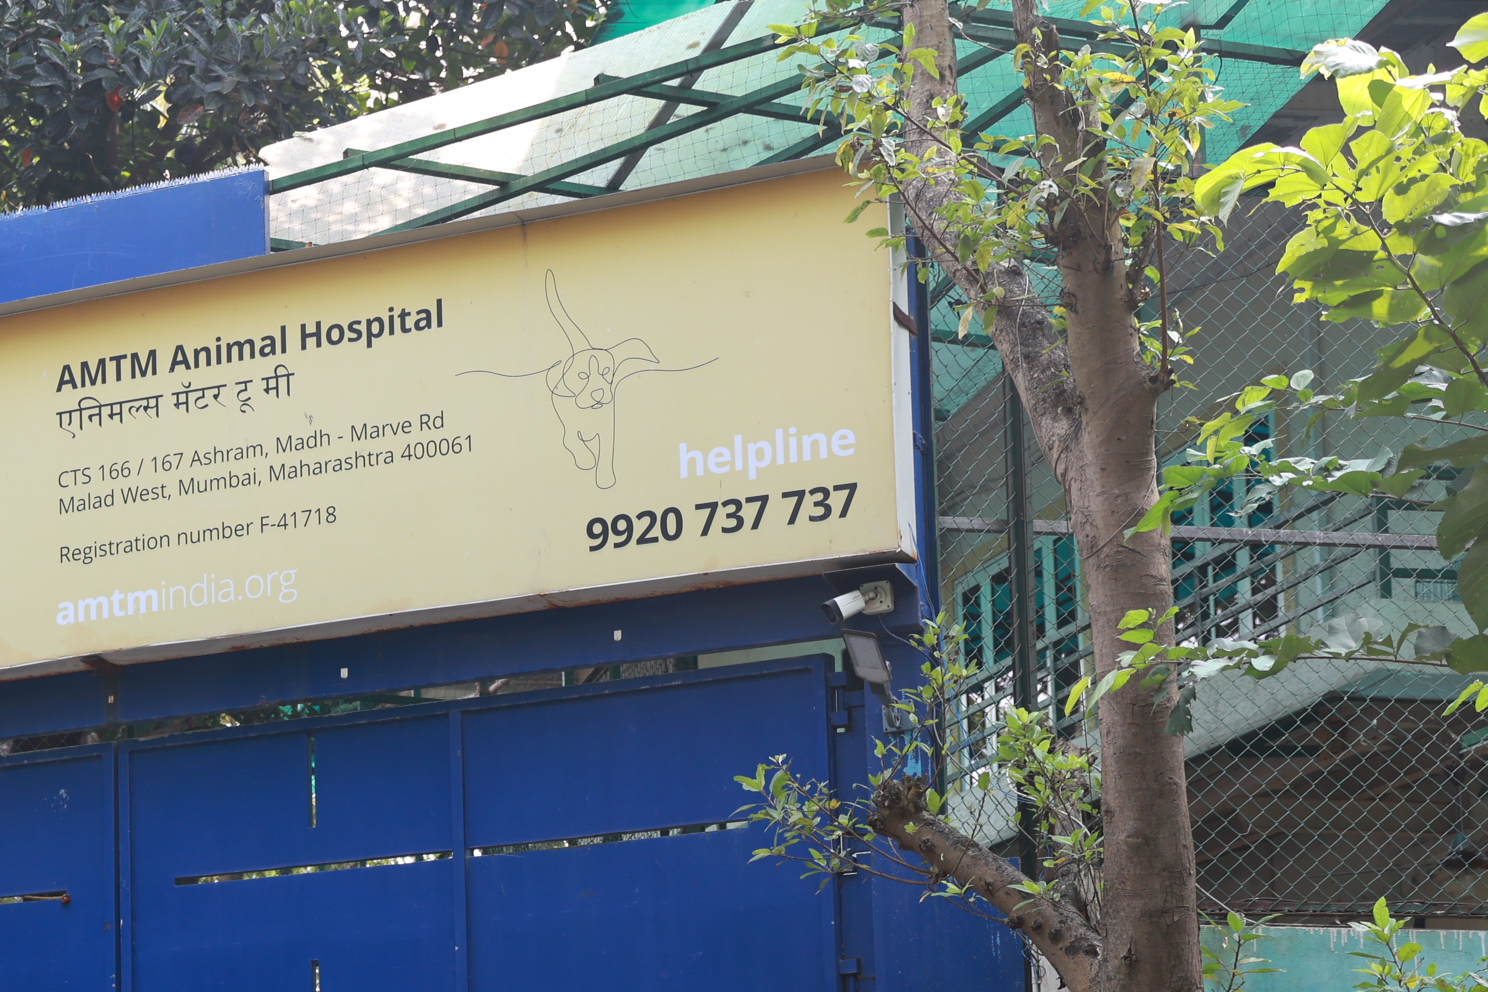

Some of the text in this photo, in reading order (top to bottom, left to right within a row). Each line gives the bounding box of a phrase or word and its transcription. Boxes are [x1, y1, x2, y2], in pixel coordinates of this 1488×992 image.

[56, 298, 442, 392] AMTM Animal Hospital
[56, 364, 294, 438] एनिमल्स मॅटर टू मी
[58, 467, 91, 488] CTS
[99, 461, 131, 481] 166
[137, 459, 144, 475] /
[151, 453, 183, 473] 167
[190, 444, 268, 467] Ashram,
[277, 430, 330, 454] Madh
[351, 421, 411, 442] Marve
[420, 410, 443, 431] Rd
[60, 435, 472, 514] Malad West, Mumbai, Maharashtra 400061
[680, 427, 856, 480] helpline
[60, 506, 336, 564] Registration number F-41718
[586, 482, 857, 552] 9920 737 737
[56, 570, 298, 625] amtmindia.org
